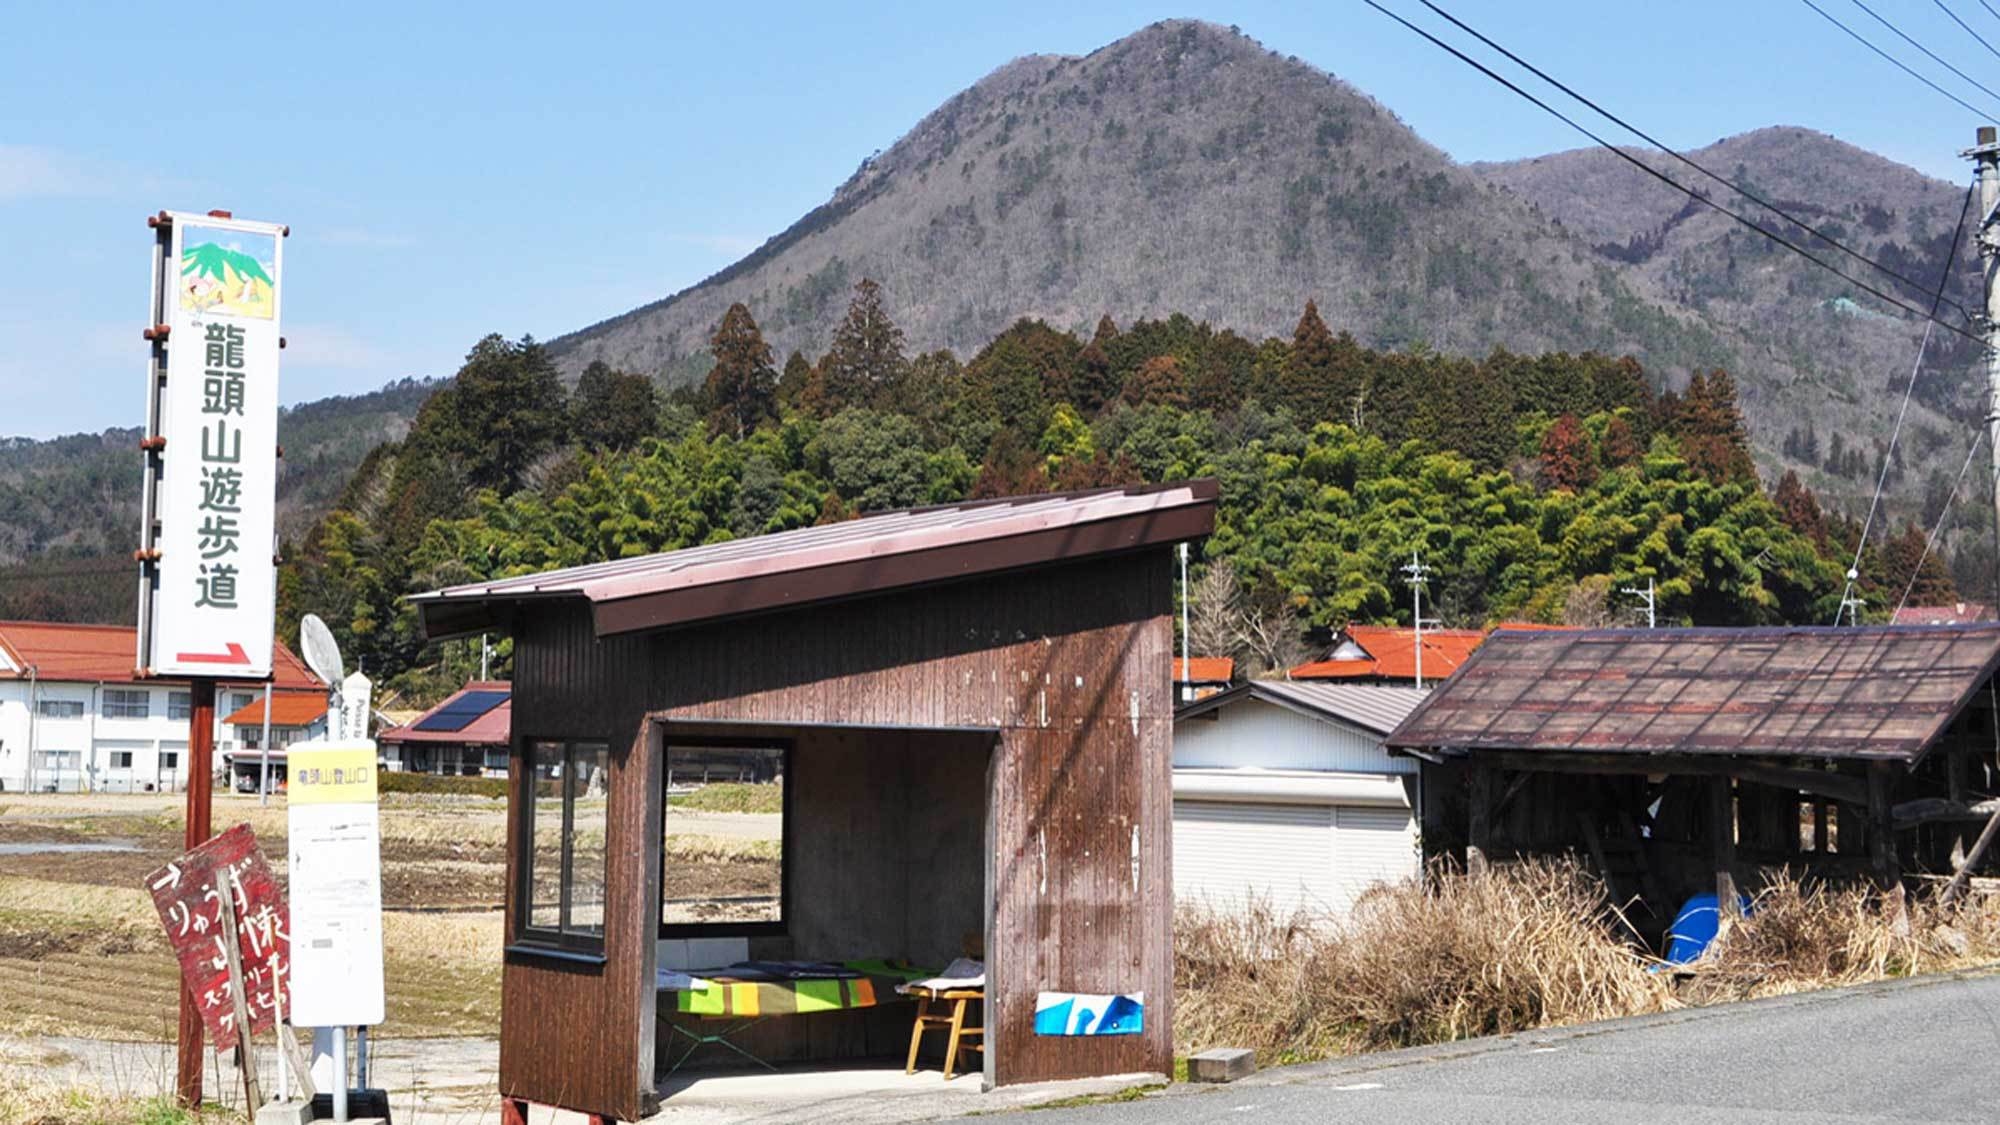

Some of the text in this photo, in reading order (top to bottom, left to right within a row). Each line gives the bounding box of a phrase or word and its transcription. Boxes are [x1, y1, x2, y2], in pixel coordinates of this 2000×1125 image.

[194, 322, 246, 610] 龍頭山遊歩道
